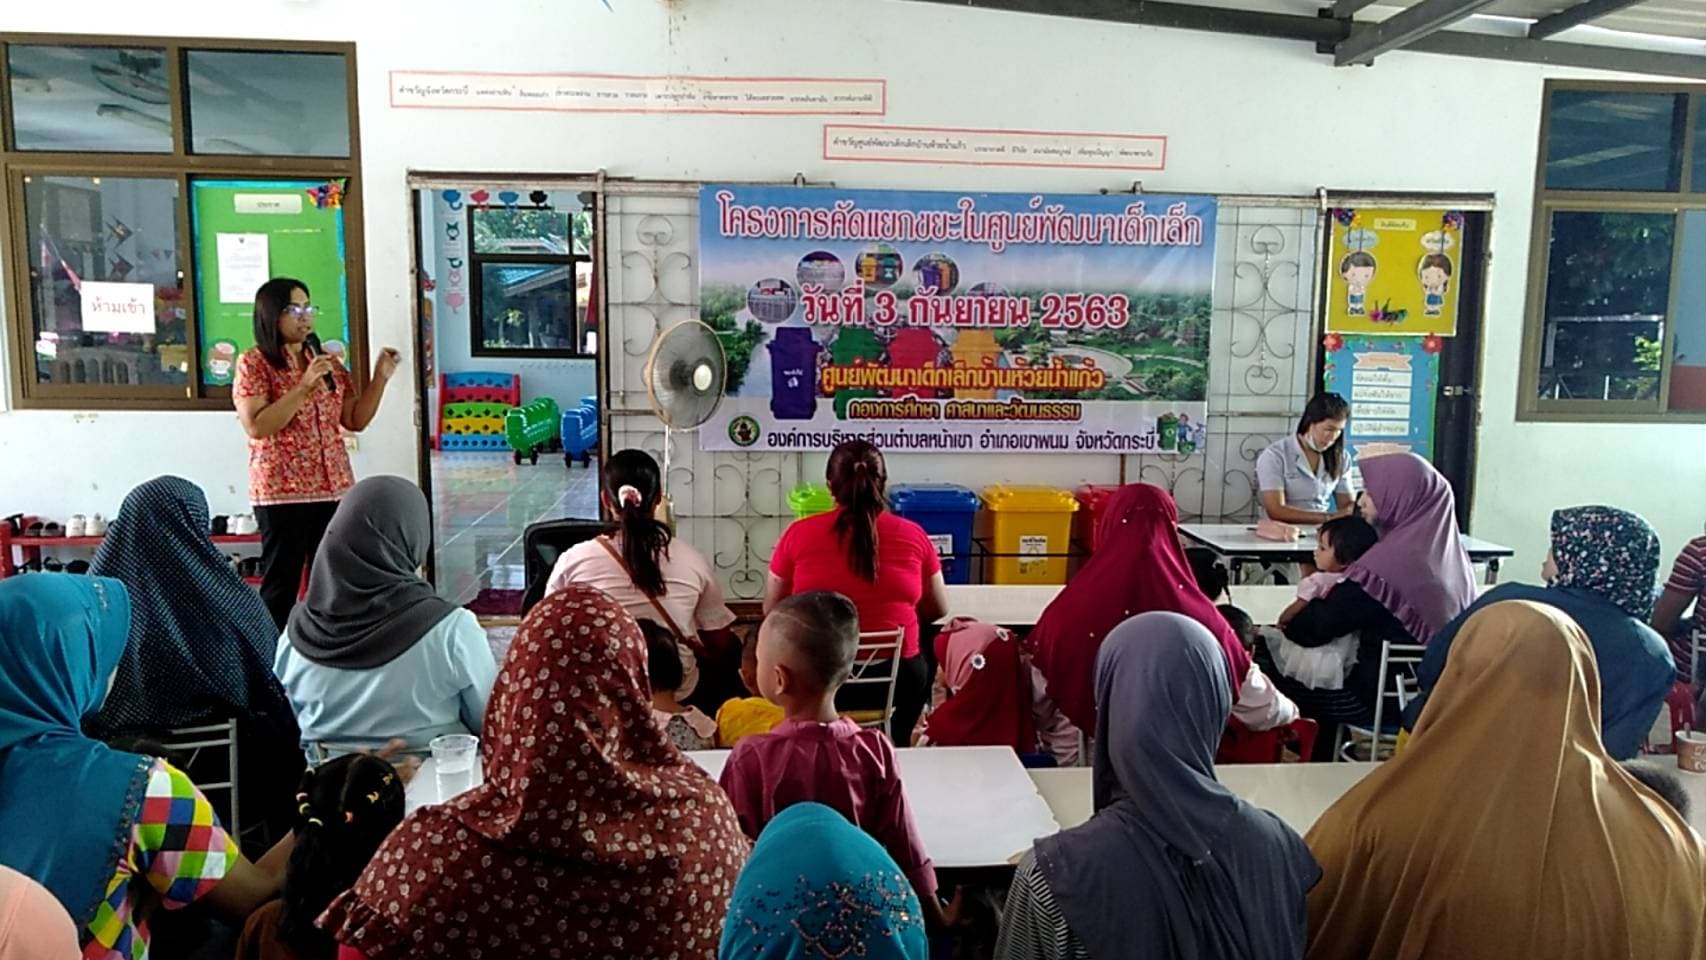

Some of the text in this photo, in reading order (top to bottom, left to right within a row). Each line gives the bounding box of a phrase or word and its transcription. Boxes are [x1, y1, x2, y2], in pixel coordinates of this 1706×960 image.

[717, 192, 1201, 252] โครงการคัดแยกขยะในศูนย์พัฒนาเด็กเล็ก
[90, 295, 147, 316] ห้ามเข้า
[800, 278, 1130, 328] วันที่ 3 กันยายน 2563
[822, 357, 1105, 396] ศูนย์พัฒนาเด็กเล็กบ้านห้วยน้ำแก้ว
[849, 396, 940, 420] กองการศึกษา
[979, 428, 1071, 451] อำเภอเขาพนม
[1075, 428, 1156, 452] จังหวัดกระบี่
